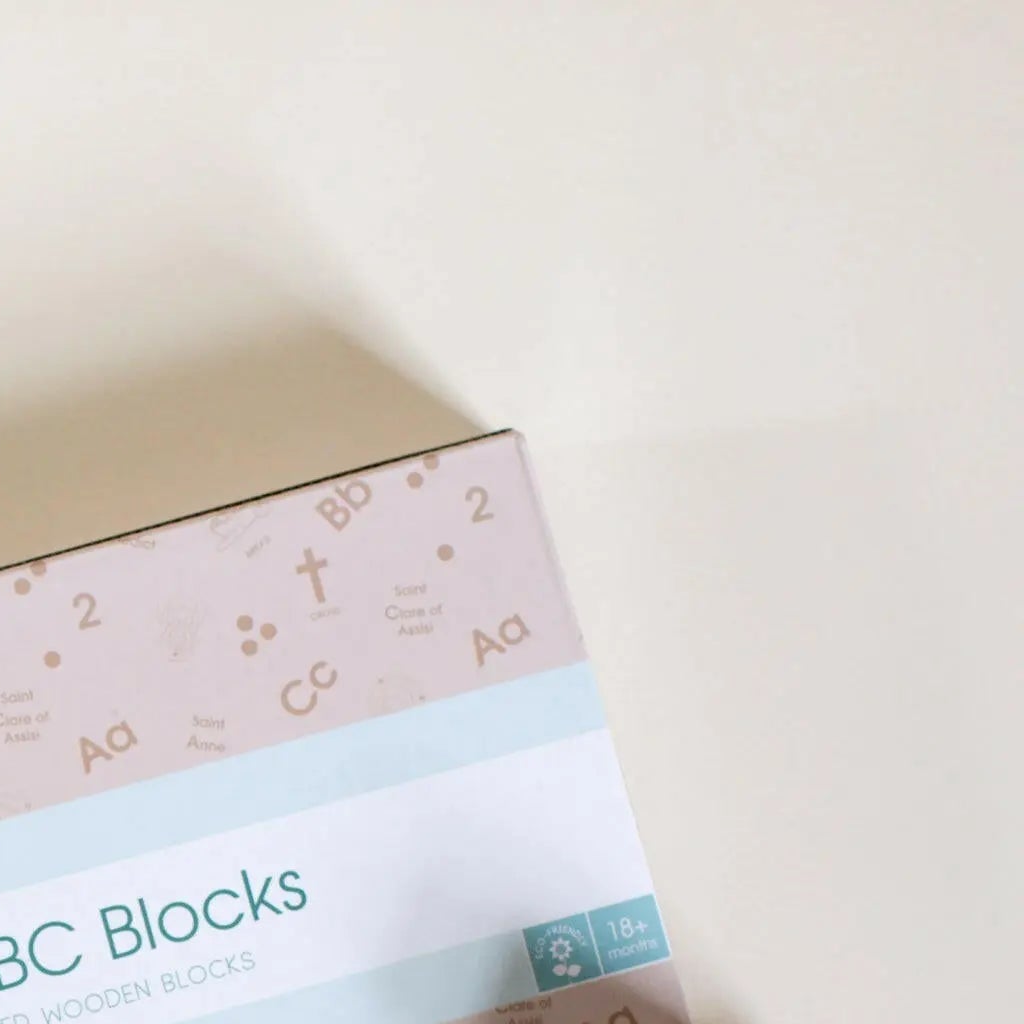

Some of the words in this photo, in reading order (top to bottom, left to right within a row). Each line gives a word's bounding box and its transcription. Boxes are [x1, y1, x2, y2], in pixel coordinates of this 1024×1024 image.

[315, 480, 372, 532] Bb
[465, 486, 494, 523] 2
[72, 592, 101, 630] 2
[429, 603, 443, 616] of
[472, 613, 531, 668] Aa
[0, 689, 34, 704] Saint
[281, 661, 338, 715] Cc
[35, 711, 50, 723] of
[192, 715, 225, 730] Saint
[79, 720, 138, 775] Aa
[186, 735, 226, 752] Anne
[99, 868, 308, 960] Blocks
[607, 917, 649, 941] 18+
[607, 937, 658, 960] months
[160, 951, 256, 993] BLOCKS
